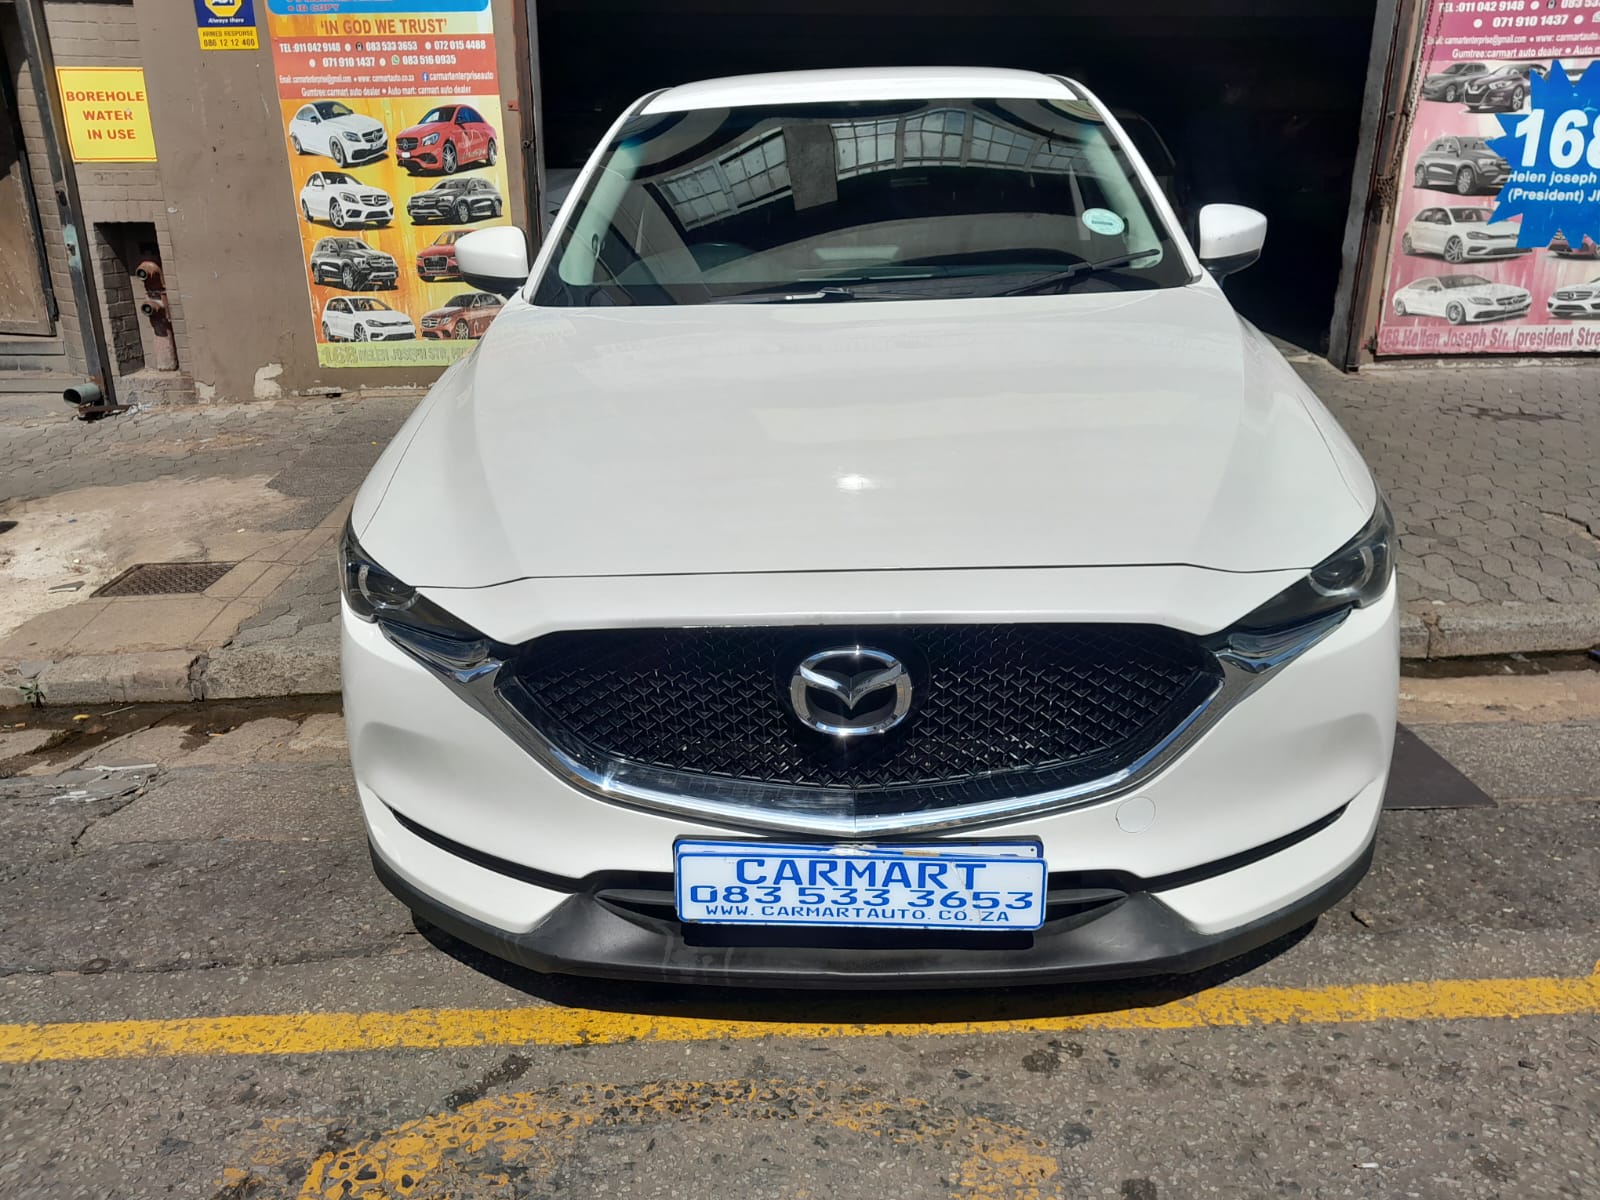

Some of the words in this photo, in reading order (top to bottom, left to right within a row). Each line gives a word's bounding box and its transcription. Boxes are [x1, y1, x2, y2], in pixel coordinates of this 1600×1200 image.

[1477, 1, 1497, 12] 042
[1499, 0, 1525, 12] 9148
[1561, 0, 1583, 9] 083
[343, 20, 371, 34] GOD
[375, 19, 396, 33] WE
[1492, 17, 1514, 28] 071
[1515, 16, 1539, 28] 910
[1540, 14, 1569, 27] 1437
[220, 39, 228, 47] 12
[231, 39, 239, 47] 12
[398, 41, 418, 51] 3653
[434, 40, 448, 50] 072
[450, 40, 464, 50] 015
[1518, 47, 1536, 57] auto
[1538, 46, 1563, 57] dealer
[1572, 44, 1594, 55] Auto
[323, 57, 338, 68] 071
[339, 57, 355, 68] 910
[356, 56, 376, 67] 1437
[420, 55, 435, 65] 516
[66, 91, 145, 102] BOREHOLE
[83, 110, 134, 121] WATER
[87, 129, 103, 140] IN
[107, 129, 137, 140] USE
[1507, 170, 1546, 183] Helen
[1548, 171, 1598, 187] joseph
[1508, 188, 1585, 204] (President)
[1443, 327, 1486, 349] Joseph
[1513, 327, 1574, 350] (president
[736, 857, 987, 890] CARMART
[690, 884, 783, 905] 083
[798, 886, 892, 908] 533
[908, 889, 1034, 910] 3653
